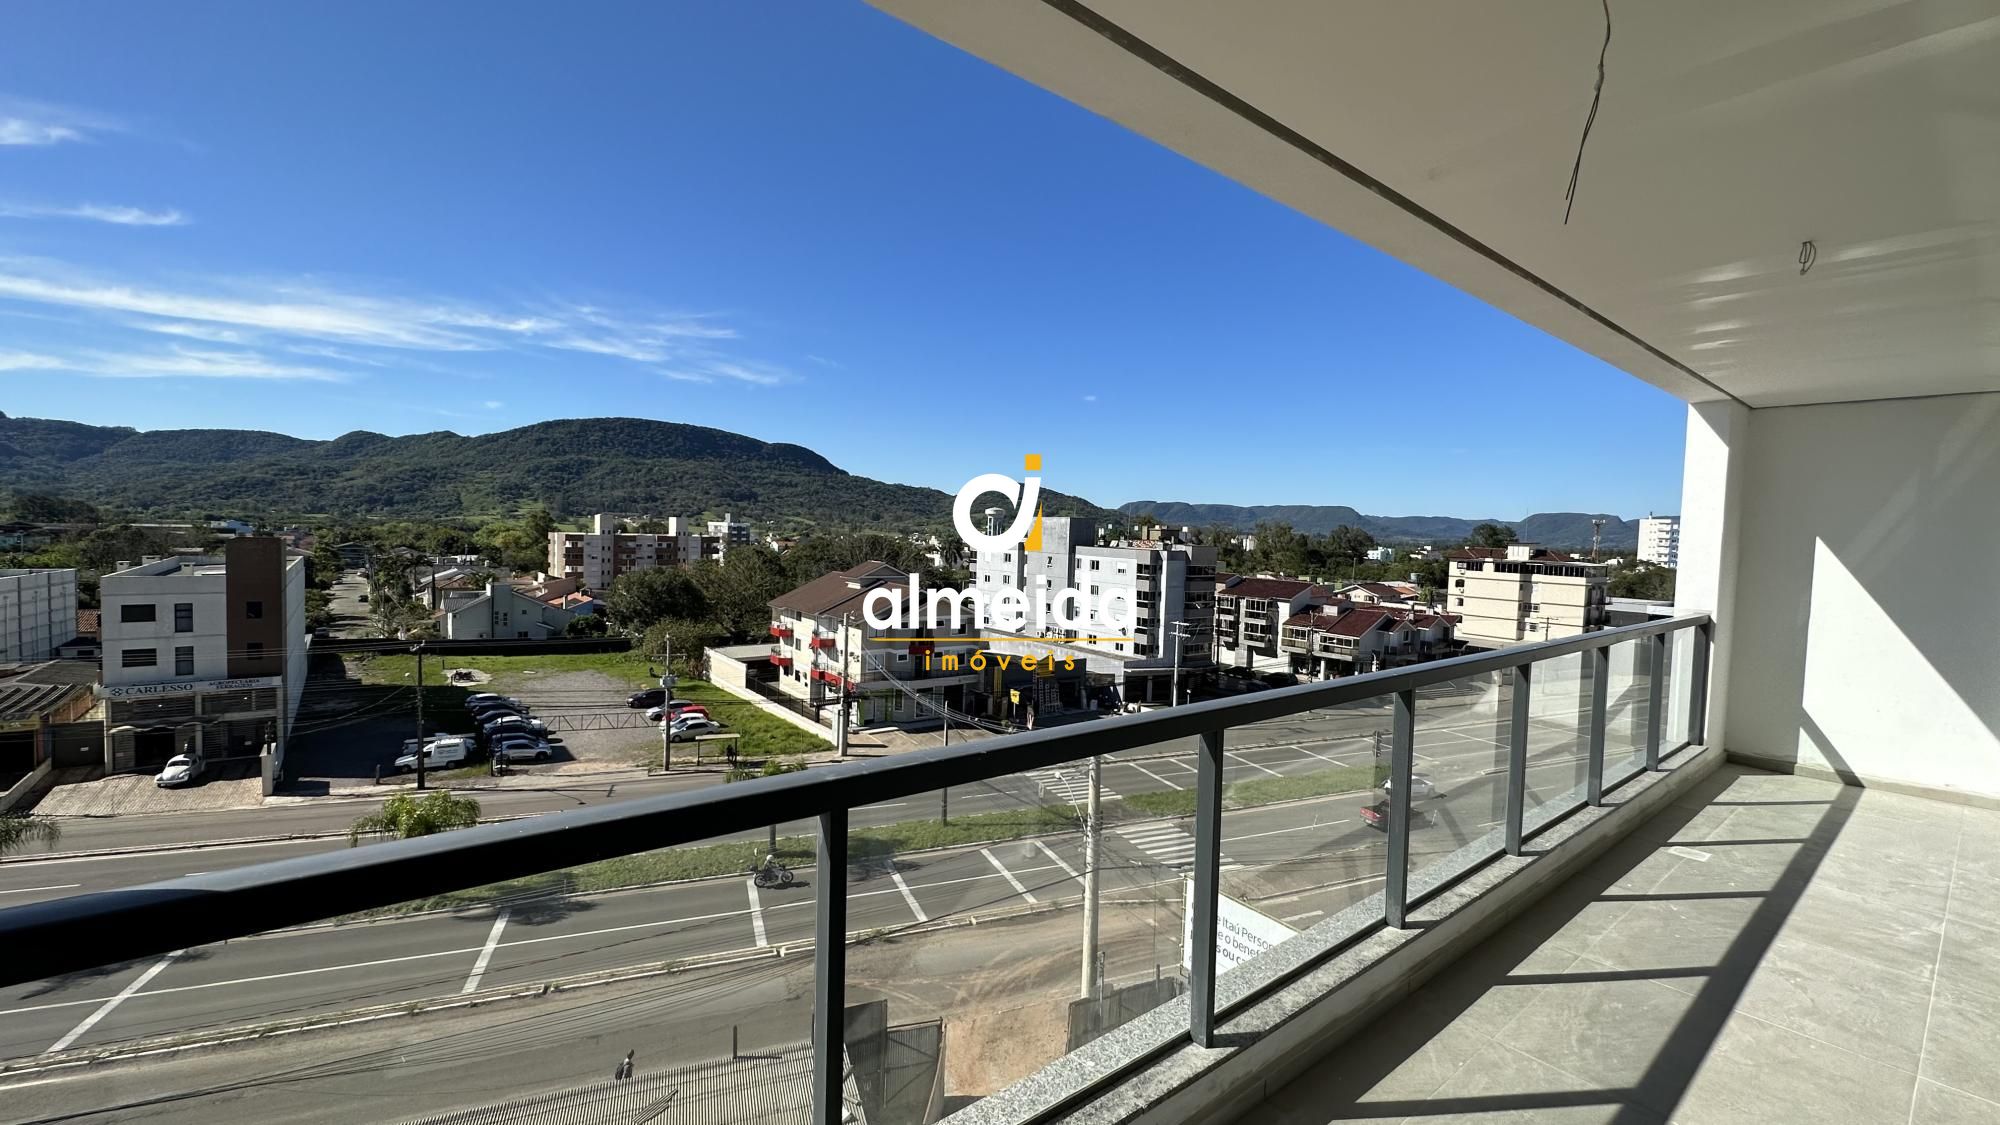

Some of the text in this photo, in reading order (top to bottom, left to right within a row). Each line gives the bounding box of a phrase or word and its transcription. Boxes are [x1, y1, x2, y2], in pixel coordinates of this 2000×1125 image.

[125, 683, 193, 695] CARLESSO
[1222, 916, 1240, 935] Itaú
[1224, 935, 1231, 944] o
[1222, 948, 1235, 961] ou
